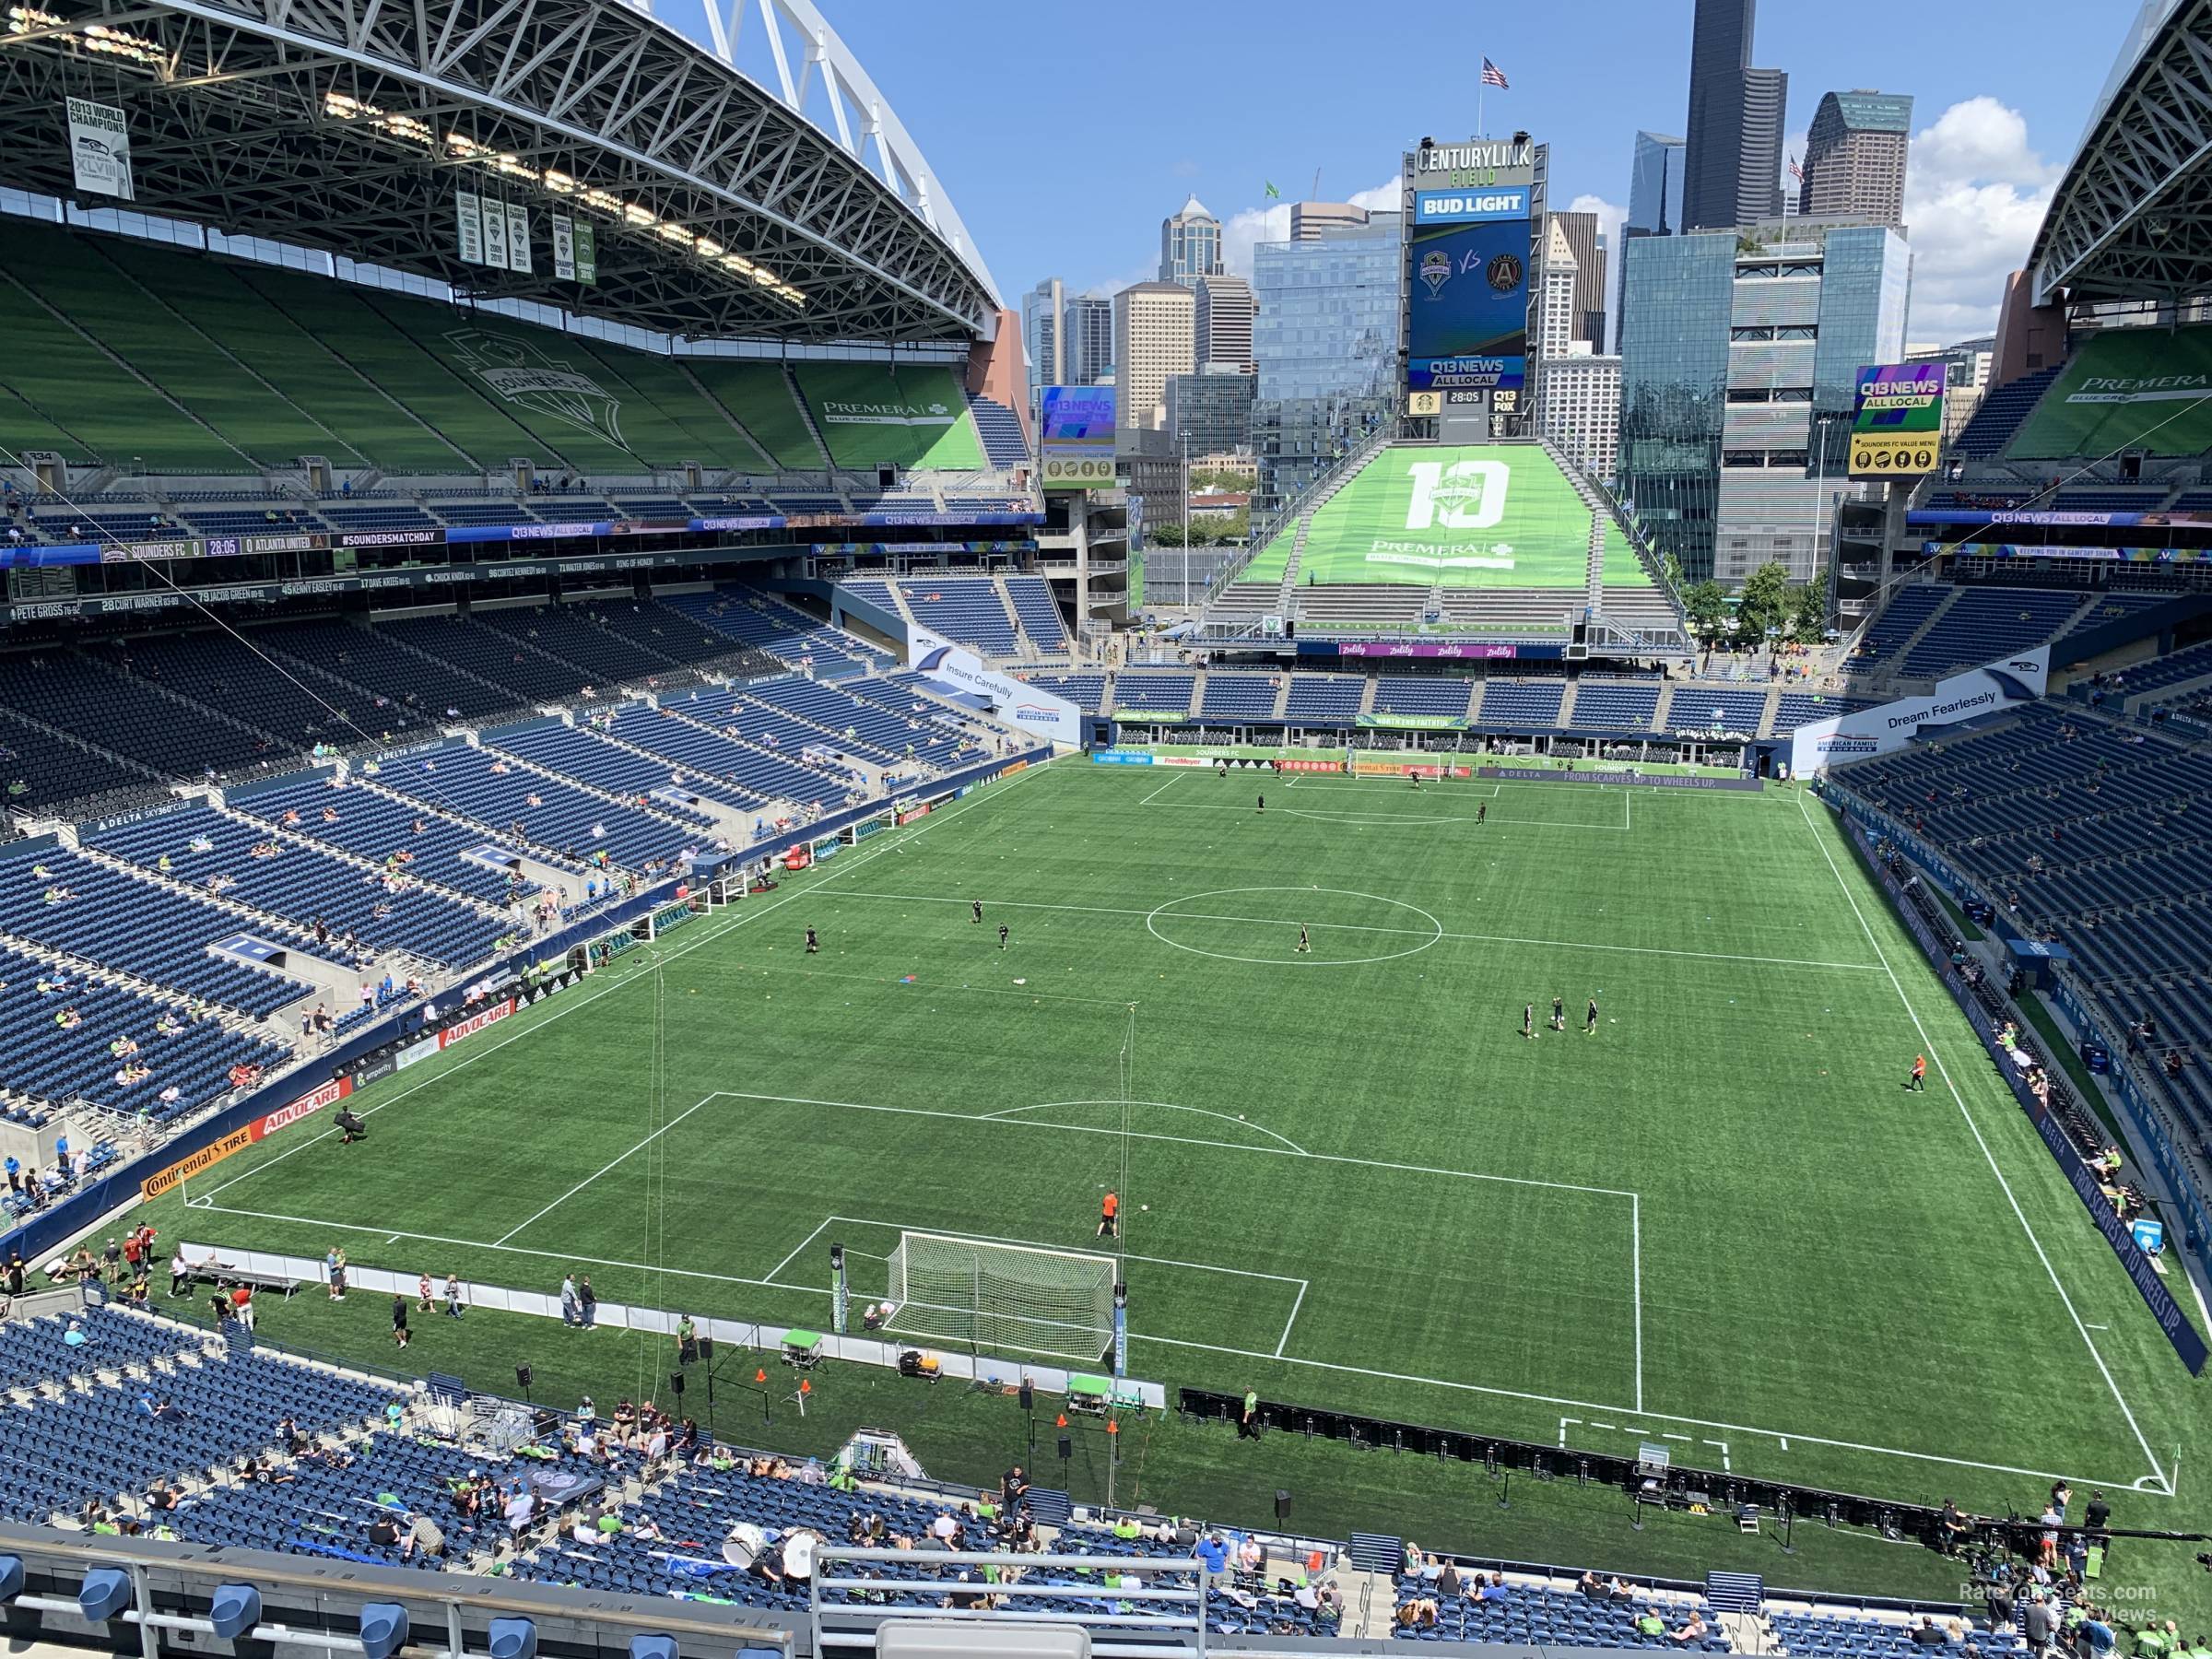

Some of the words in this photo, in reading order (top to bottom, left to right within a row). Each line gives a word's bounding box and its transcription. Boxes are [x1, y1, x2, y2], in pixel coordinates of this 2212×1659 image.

[69, 100, 91, 115] 2013
[92, 105, 124, 122] WORLD
[70, 112, 124, 134] CHAMPIONS
[1451, 170, 1496, 185] FIELD
[484, 206, 502, 216] CHAMPS
[1424, 198, 1464, 215] BUD
[1465, 195, 1522, 212] LIGHT
[509, 211, 527, 221] CHAMPS
[555, 223, 571, 233] SHIELD
[555, 259, 574, 270] CHAMPS
[1458, 249, 1481, 275] VS
[1430, 361, 1459, 374] Q13
[1459, 359, 1504, 372] NEWS
[494, 376, 571, 391] SOUNDERS
[571, 379, 594, 393] FC
[1435, 376, 1454, 385] ALL
[1458, 375, 1494, 384] LOCAL
[2079, 374, 2207, 391] PREMERA
[1861, 382, 1888, 396] Q13
[1890, 380, 1938, 394] NEWS
[1451, 392, 1479, 402] 28:05
[1493, 391, 1517, 402] Q13
[1866, 399, 1887, 407] ALL
[1890, 397, 1927, 406] LOCAL
[823, 401, 919, 415] PREMERA
[1072, 400, 1112, 412] NEWS
[1494, 402, 1514, 412] FOX
[703, 520, 716, 530] Q13
[715, 519, 737, 529] NEWS
[751, 519, 769, 527] LOCAL
[885, 514, 902, 525] Q13
[902, 514, 931, 524] NEWS
[950, 515, 973, 524] LOCAL
[1991, 513, 2014, 524] Q13
[2015, 512, 2051, 524] NEWS
[2074, 515, 2105, 524] LOCAL
[512, 526, 528, 538] Q13
[528, 525, 553, 537] NEWS
[556, 525, 570, 535] ALL
[570, 524, 592, 535] LOCAL
[342, 532, 435, 546] #SOUNDERSMATCHDAY
[132, 545, 174, 559] SOUNDERS
[175, 544, 185, 557] FC
[193, 542, 199, 556] 0
[210, 540, 236, 555] 28:05
[246, 539, 253, 552] 0
[255, 537, 285, 551] ATLANTA
[287, 535, 311, 549] UNITED
[1371, 540, 1479, 556] PREMERA
[616, 559, 629, 569] RING
[630, 559, 636, 568] OF
[637, 558, 654, 567] HONOR
[433, 572, 451, 582] CHUCK
[451, 571, 465, 582] KNOX
[488, 569, 498, 579] 96
[281, 585, 293, 595] 45
[292, 583, 312, 594] KENNY
[312, 582, 333, 593] EASLEY
[360, 579, 369, 589] 17
[369, 577, 382, 588] DAVE
[382, 576, 399, 586] KRIEG
[197, 592, 210, 603] 79
[209, 590, 229, 602] JACOB
[230, 589, 251, 600] GREEN
[101, 601, 115, 611] 28
[114, 598, 134, 611] CURT
[134, 596, 163, 609] WARNER
[17, 606, 37, 620] PETE
[37, 605, 64, 618] GROSS
[946, 663, 973, 681] Insure
[974, 675, 1013, 700] Carefully
[590, 706, 609, 715] DELTA
[1888, 710, 1929, 729] Dream
[1932, 691, 1996, 717] Fearlessly
[1376, 717, 1399, 726] NORTH
[1401, 718, 1416, 726] END
[1417, 719, 1448, 727] FAITHFUL
[2176, 713, 2192, 724] DELTA
[384, 749, 408, 759] DELTA
[1196, 748, 1230, 757] SOUNDERS
[1509, 771, 1541, 779] DELTA
[1564, 771, 1590, 782] FROM
[1592, 772, 1629, 784] SCARVES
[1631, 774, 1645, 784] UP
[1648, 776, 1661, 785] TO
[1663, 776, 1700, 787] WHEELS
[1701, 778, 1716, 788] UP.
[109, 813, 142, 828] DELTA
[444, 1003, 510, 1046] ADVOCARE
[409, 1042, 434, 1058] amperity
[366, 1063, 392, 1081] amperity
[263, 1084, 340, 1135] ADVOCARE
[222, 1131, 249, 1155] TIRE
[2044, 1125, 2065, 1158] DELTA
[2074, 1166, 2093, 1202] FROM
[2090, 1197, 2120, 1245] SCARVES
[2115, 1231, 2130, 1256] UP
[2125, 1246, 2140, 1272] TO
[2135, 1263, 2170, 1317] WHEELS
[2163, 1307, 2181, 1337] UP.
[832, 1281, 840, 1289] FC
